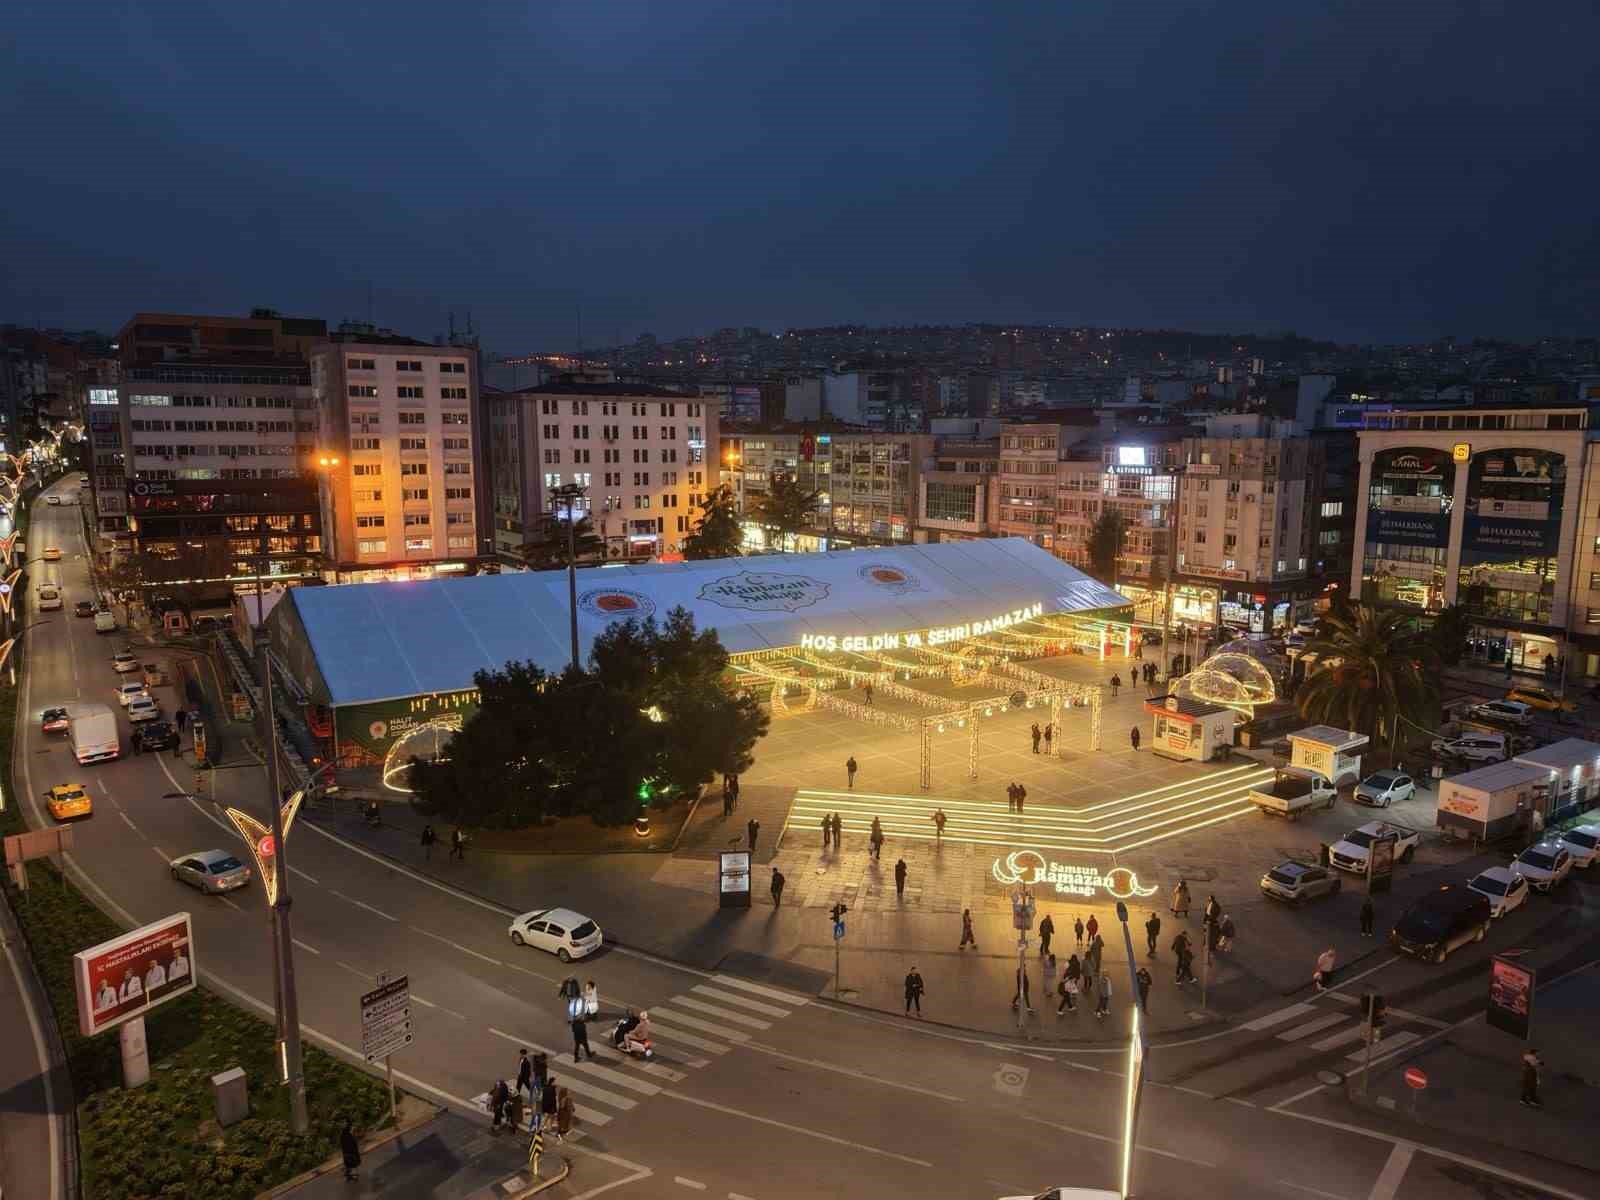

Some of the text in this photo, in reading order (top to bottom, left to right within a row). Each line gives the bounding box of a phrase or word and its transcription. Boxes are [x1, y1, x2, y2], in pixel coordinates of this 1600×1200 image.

[1391, 519, 1435, 530] HALKBANK
[1490, 527, 1541, 538] HALKBANK
[715, 578, 811, 596] Ramazan
[842, 632, 899, 651] GELDİN
[906, 632, 922, 648] YA
[973, 604, 1042, 634] RAMAZAN
[1049, 861, 1098, 875] Samsun
[1034, 867, 1114, 889] Ramazan
